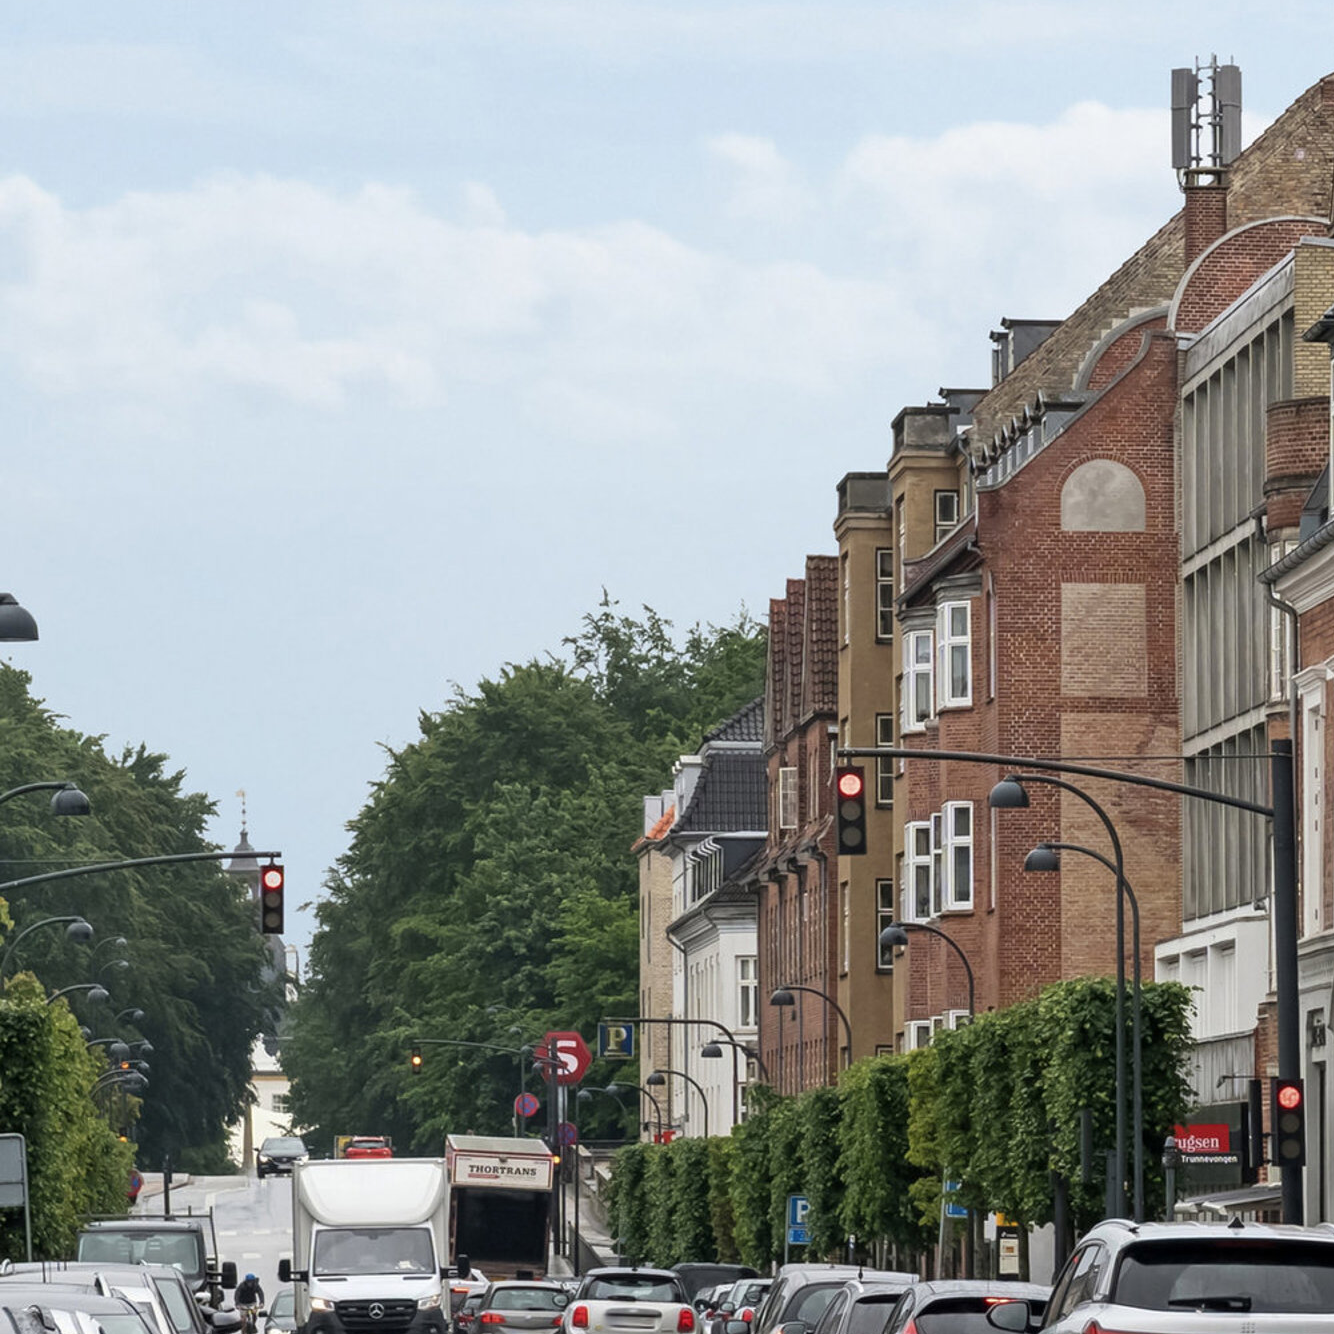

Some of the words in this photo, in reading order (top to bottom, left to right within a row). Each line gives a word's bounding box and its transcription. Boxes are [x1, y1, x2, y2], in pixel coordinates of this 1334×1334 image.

[607, 1027, 628, 1050] P
[548, 1040, 579, 1075] S
[468, 1164, 537, 1176] THORTRANS
[797, 1200, 811, 1223] P
